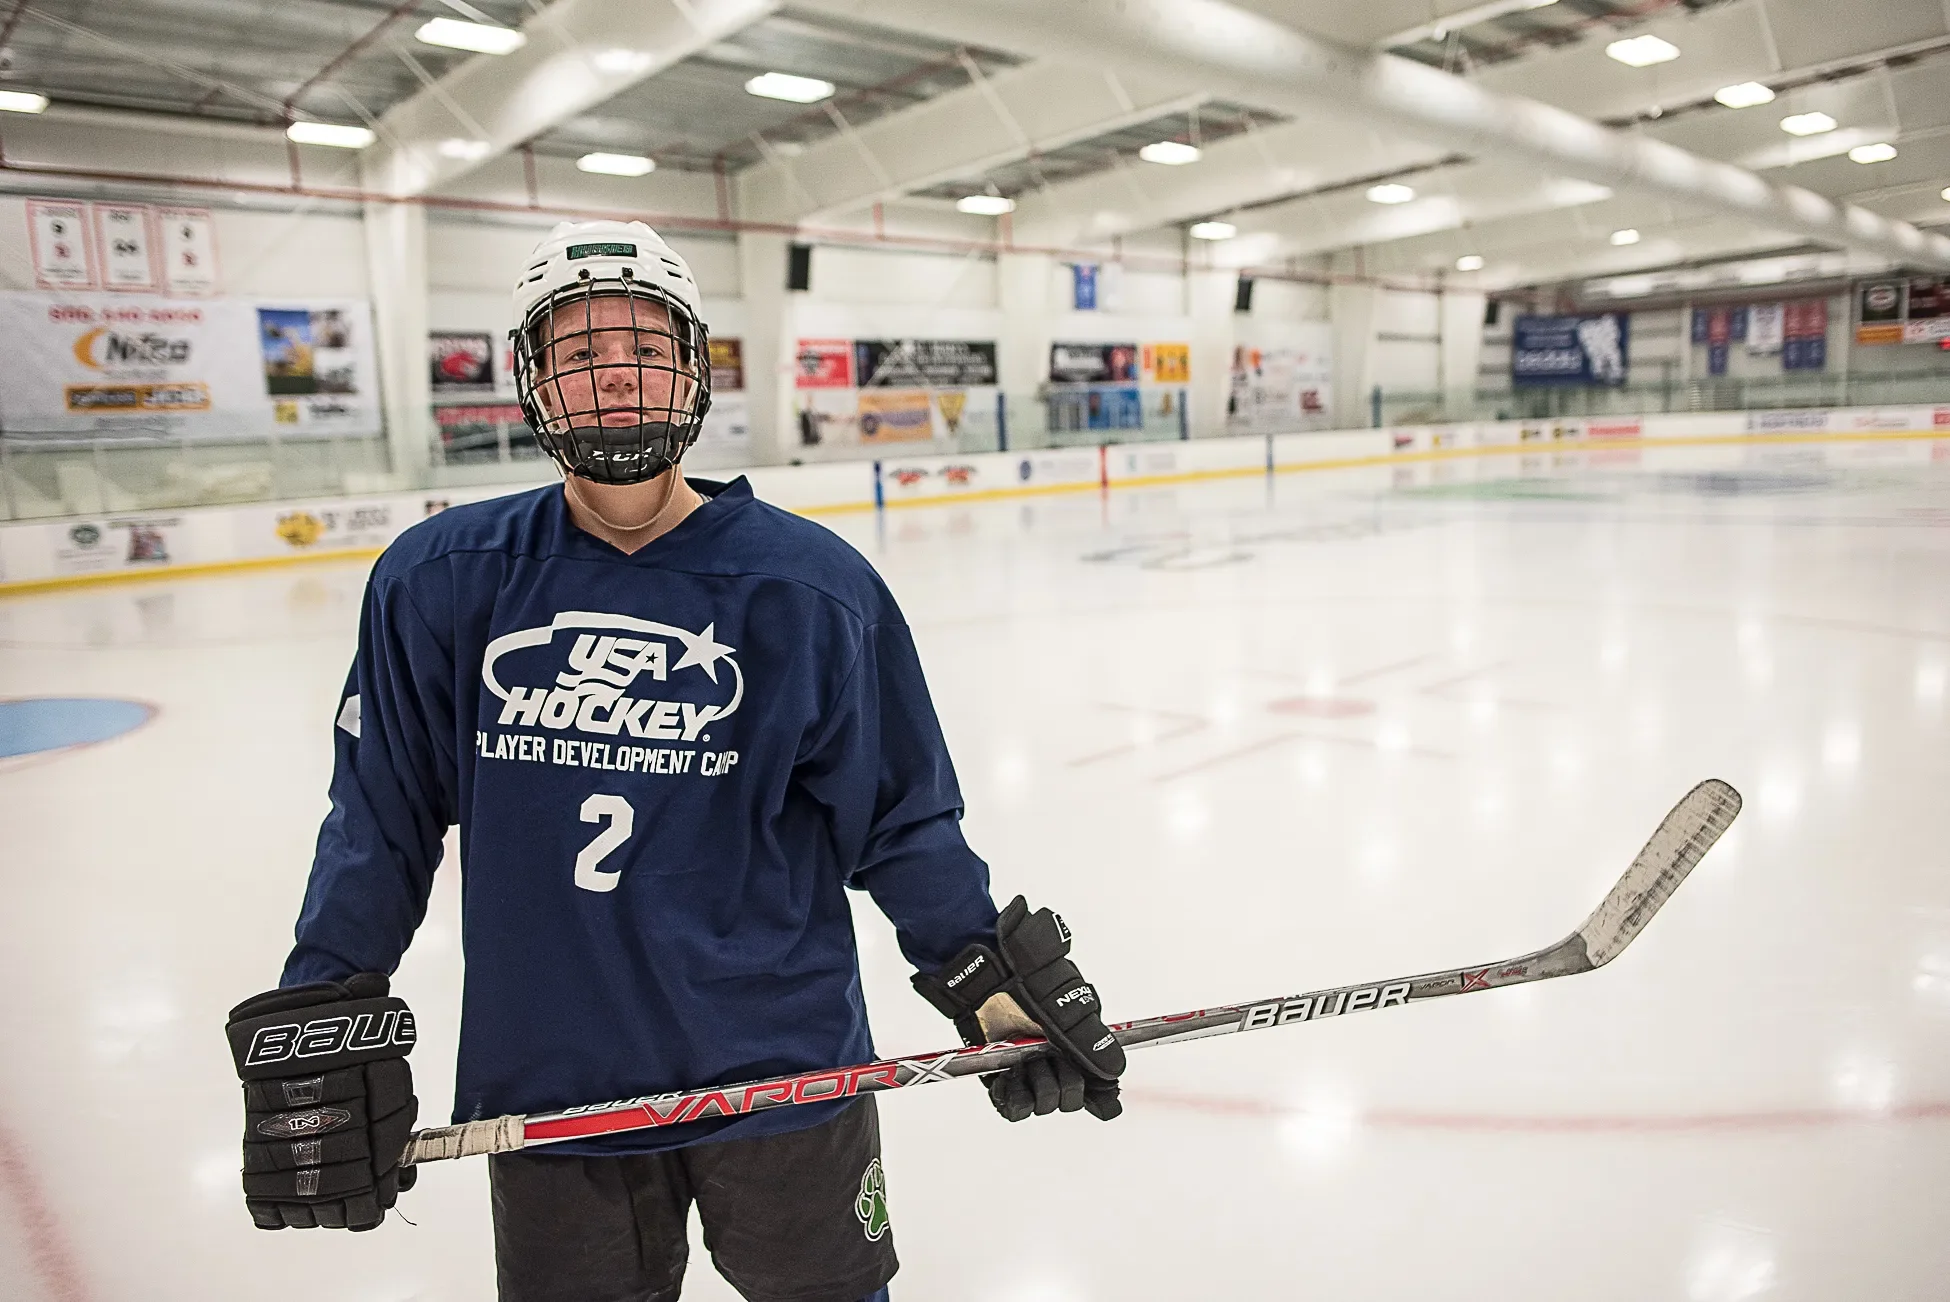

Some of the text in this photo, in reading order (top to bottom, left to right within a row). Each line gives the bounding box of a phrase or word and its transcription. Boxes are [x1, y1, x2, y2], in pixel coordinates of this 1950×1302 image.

[556, 633, 667, 688] USA
[497, 684, 722, 742] HOCKEY
[476, 730, 739, 777] PLAYER DEVELOPMENT CAMP
[574, 792, 635, 893] 2
[946, 955, 986, 988] BAUER
[1243, 982, 1411, 1032] BAUER
[640, 1062, 904, 1127] VAPOR
